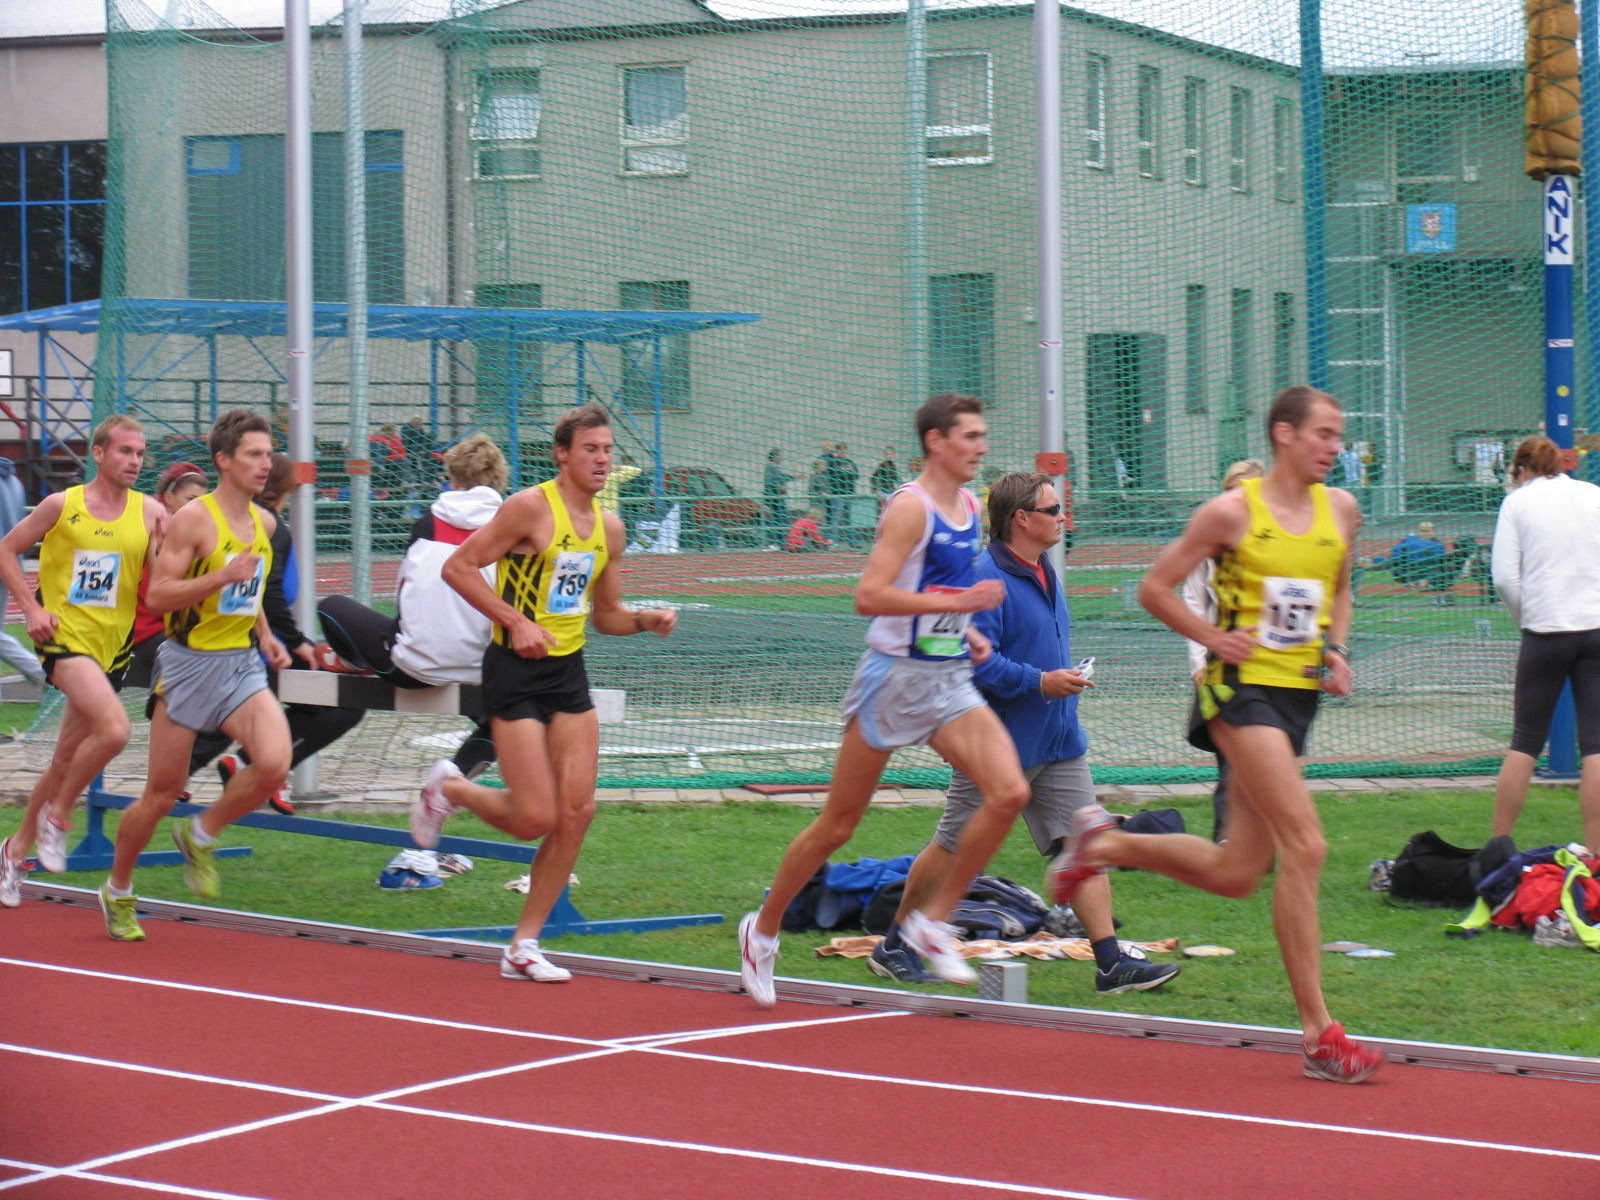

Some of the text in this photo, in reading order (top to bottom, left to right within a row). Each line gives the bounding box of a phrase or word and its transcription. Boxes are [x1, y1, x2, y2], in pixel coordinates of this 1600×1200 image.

[1548, 176, 1572, 255] ANIK
[78, 570, 114, 591] 154
[558, 574, 587, 596] 159
